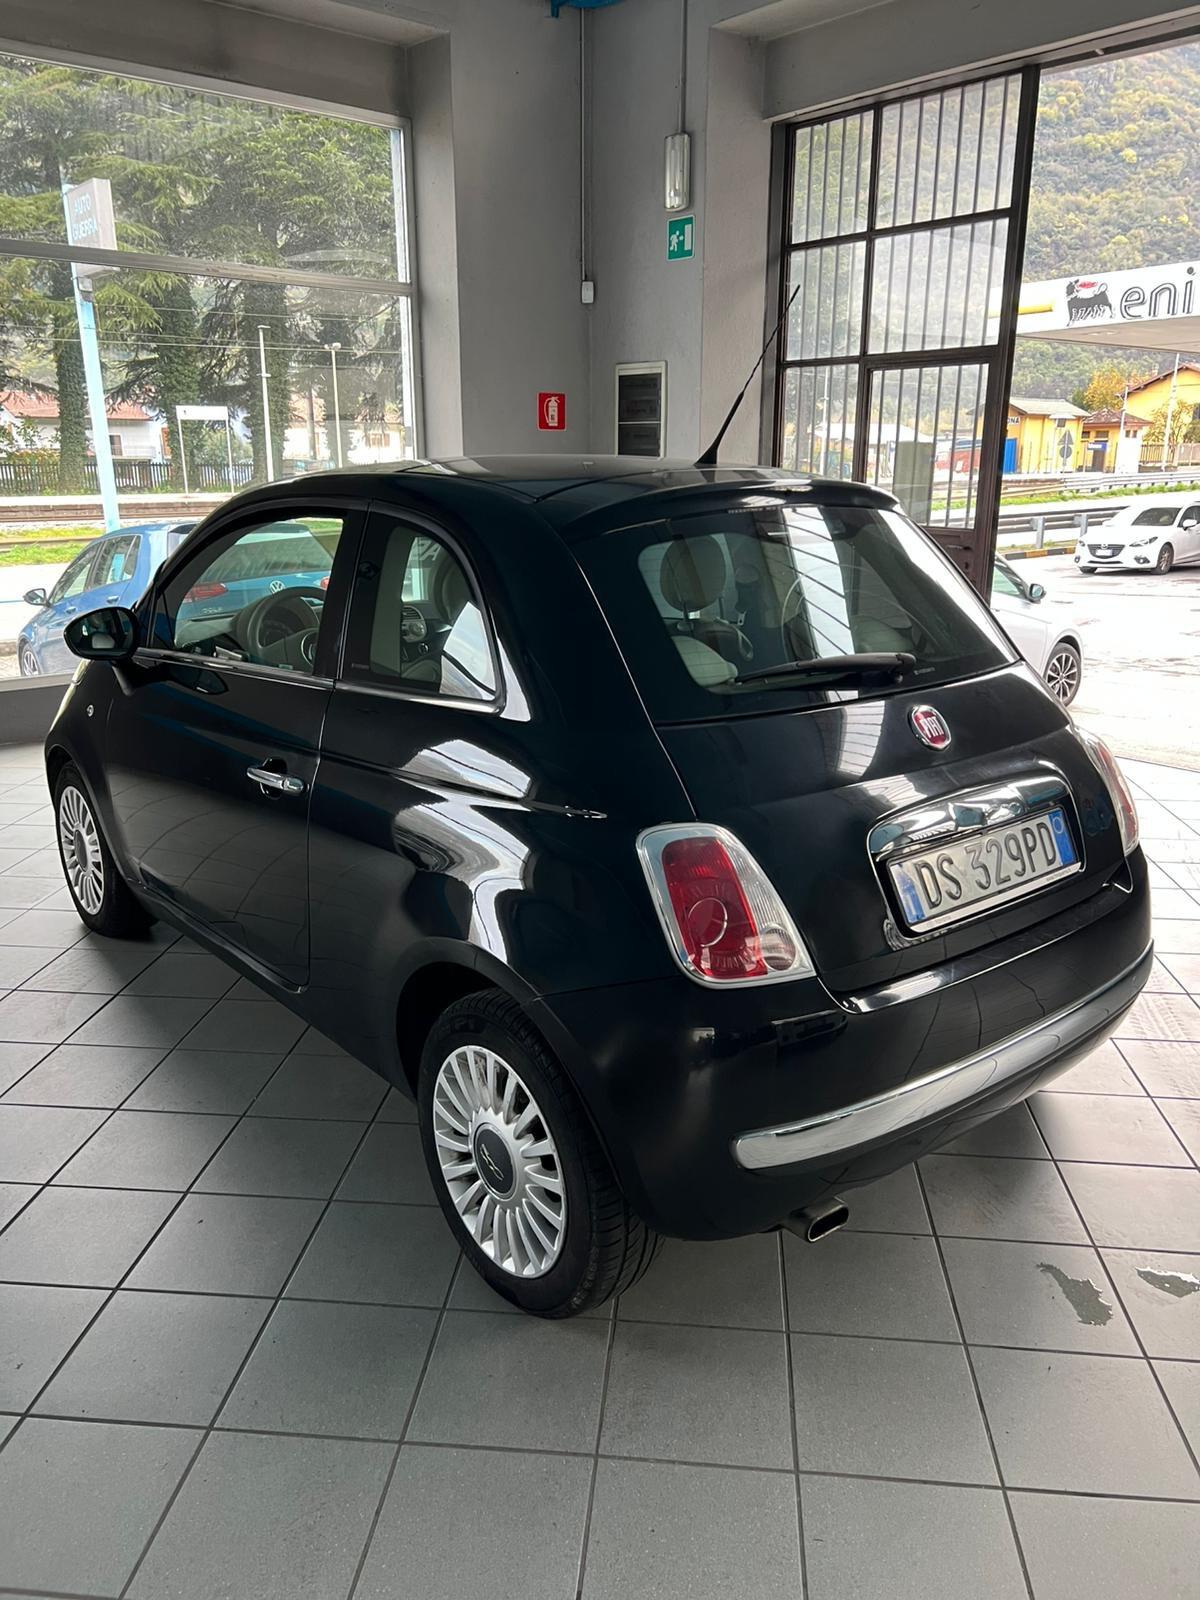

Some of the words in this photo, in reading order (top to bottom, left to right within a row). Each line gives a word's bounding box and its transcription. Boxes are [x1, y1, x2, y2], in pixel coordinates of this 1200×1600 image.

[1120, 266, 1195, 320] eni
[919, 716, 944, 738] FIAT
[914, 852, 962, 909] DS
[965, 822, 1057, 890] 329PD
